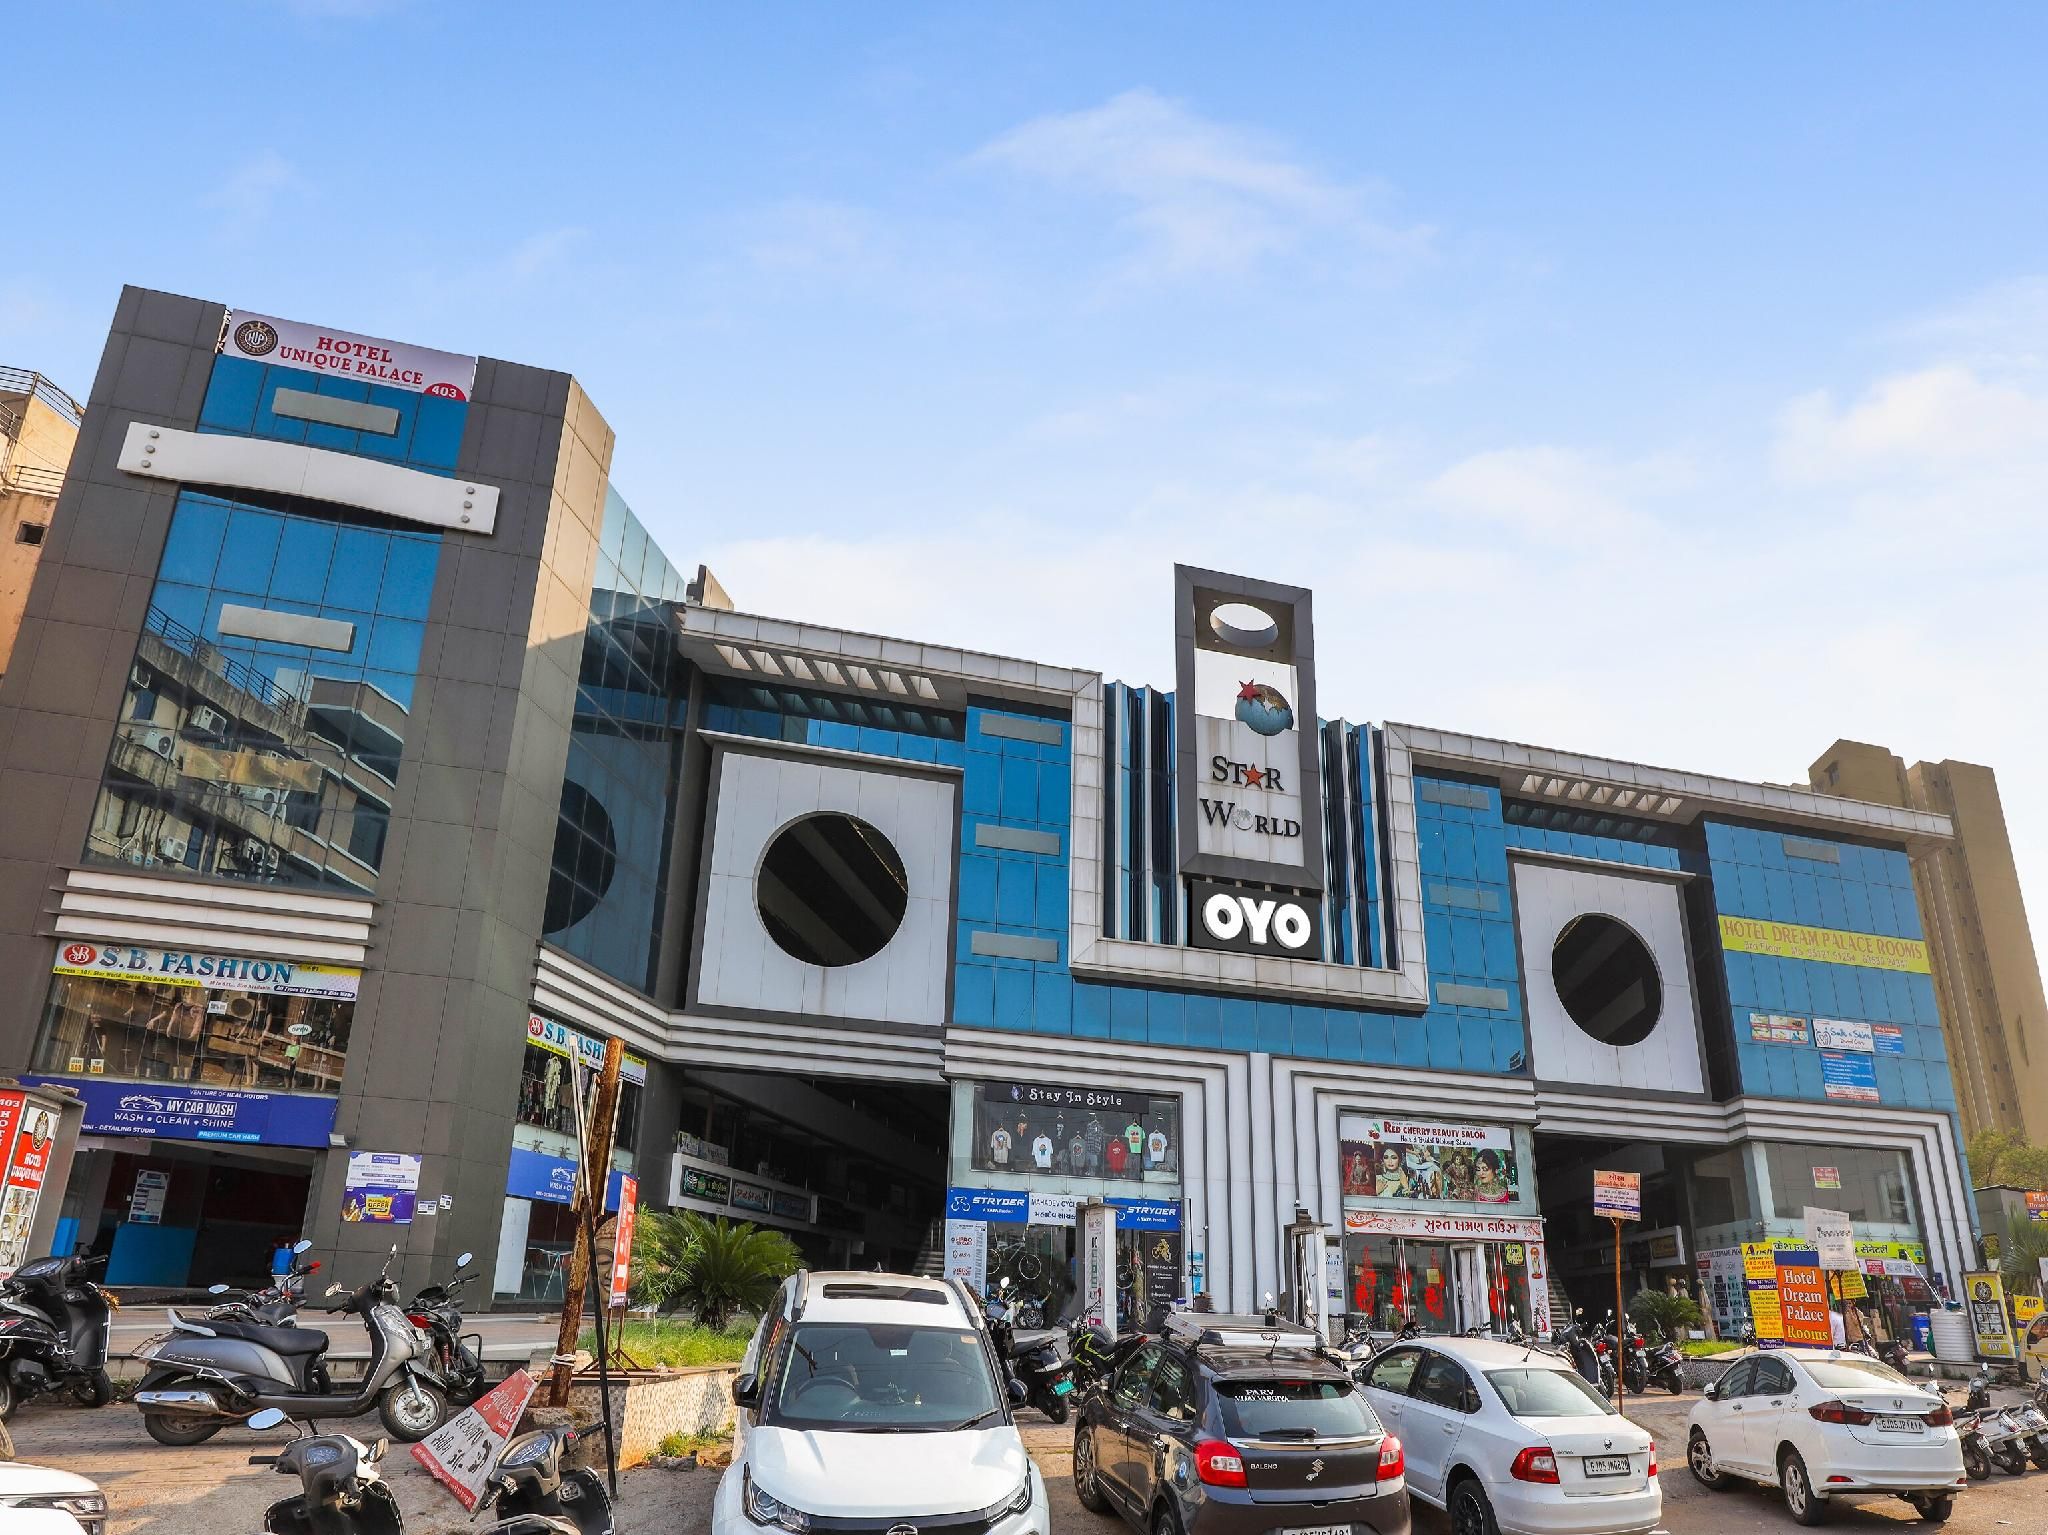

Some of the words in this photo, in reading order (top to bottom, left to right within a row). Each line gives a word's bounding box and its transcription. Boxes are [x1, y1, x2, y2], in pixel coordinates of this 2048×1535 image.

[316, 336, 392, 362] HOTEL
[279, 345, 351, 371] UNIQUE
[356, 361, 424, 385] PALACE
[431, 384, 458, 398] 403
[1202, 893, 1312, 949] OYO
[1723, 919, 1768, 940] HOTEL
[1771, 925, 1819, 946] DREAM
[1822, 932, 1874, 954] PALACE
[1876, 938, 1924, 960] ROOMS
[99, 945, 153, 972] S.B.
[159, 952, 294, 984] FASHION
[1029, 1088, 1062, 1103] Stay
[1065, 1091, 1082, 1103] In
[1086, 1092, 1122, 1106] Style
[166, 1100, 183, 1113] MY
[183, 1101, 204, 1114] CAR
[205, 1102, 235, 1116] WASH
[114, 1112, 144, 1122] WASH
[155, 1115, 191, 1126] CLEAN
[202, 1118, 234, 1128] SHINE
[99, 1124, 132, 1132] DETAILING
[132, 1126, 156, 1134] STUDIO
[198, 1131, 227, 1140] PREMIUM
[1403, 1126, 1431, 1136] CHERRY
[1432, 1128, 1460, 1138] BEAUTY
[1461, 1130, 1486, 1140] SALON
[972, 1196, 1026, 1207] STRYDER
[1127, 1206, 1177, 1216] STRYDER
[1454, 1220, 1484, 1233] ખમણ
[1487, 1218, 1517, 1234] હાઉસ
[1784, 1269, 1817, 1285] Hotel
[1783, 1287, 1823, 1304] Dream
[1786, 1305, 1824, 1322] Palace
[1786, 1324, 1828, 1341] Rooms
